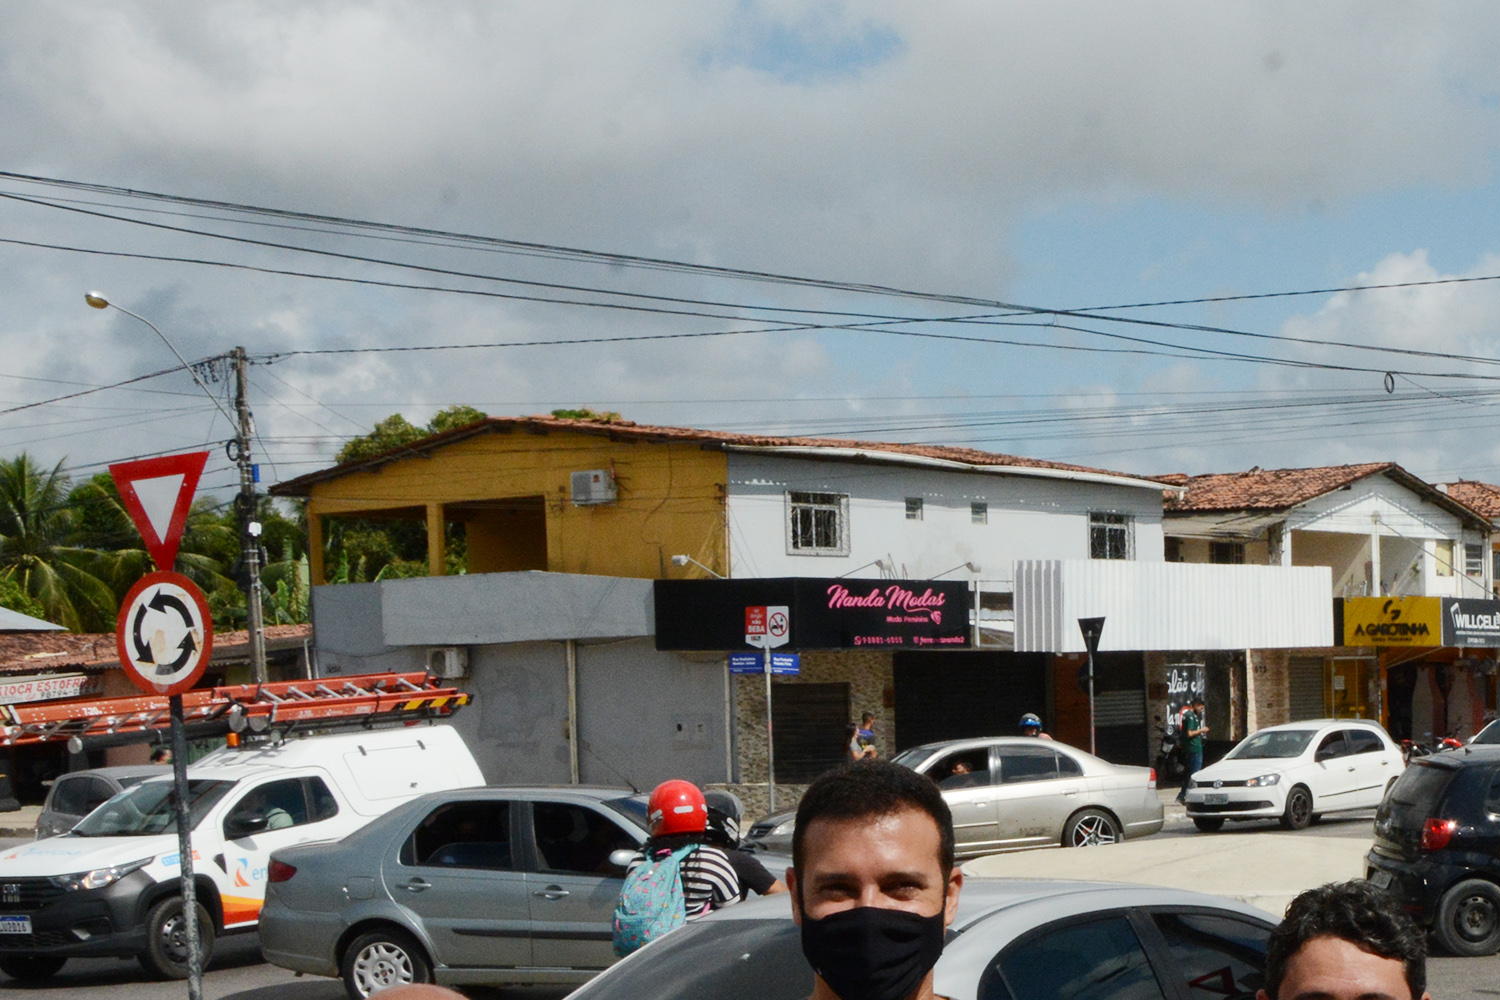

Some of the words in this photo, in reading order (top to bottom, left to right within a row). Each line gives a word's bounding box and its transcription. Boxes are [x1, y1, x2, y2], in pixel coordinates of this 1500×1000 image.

[827, 584, 886, 609] Nanda
[885, 585, 946, 610] Modas
[1355, 623, 1365, 636] A
[37, 677, 98, 692] ESTOFADOS
